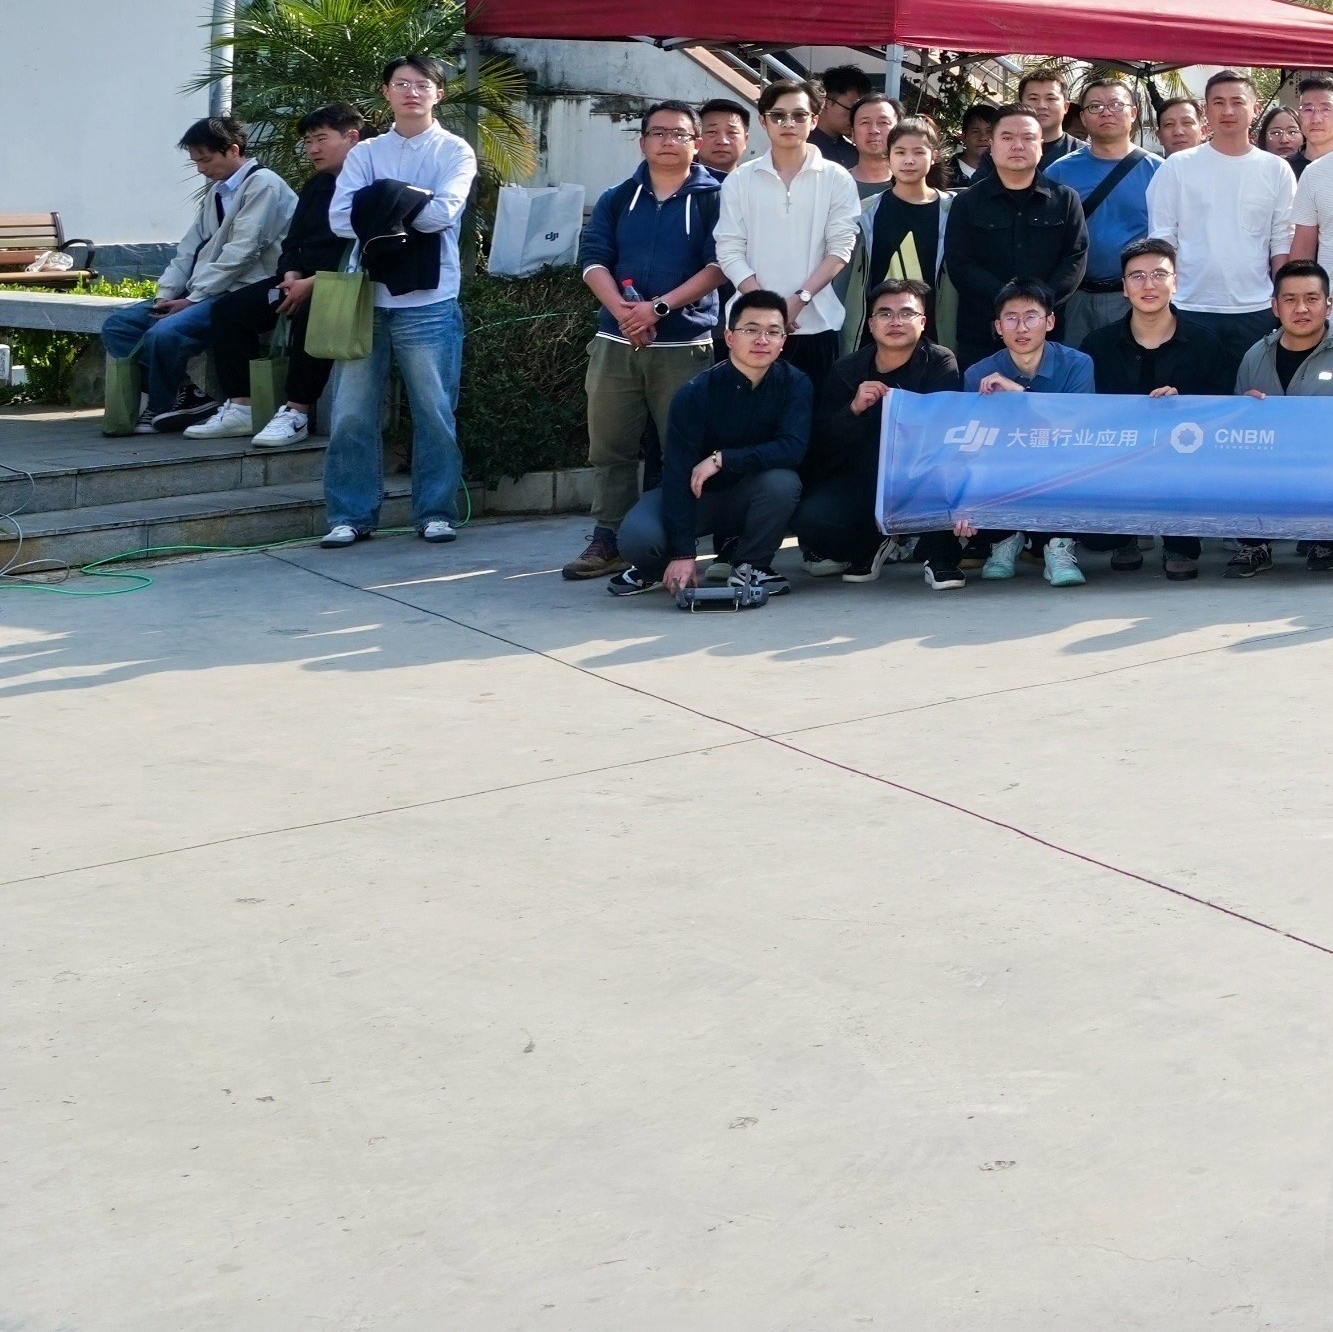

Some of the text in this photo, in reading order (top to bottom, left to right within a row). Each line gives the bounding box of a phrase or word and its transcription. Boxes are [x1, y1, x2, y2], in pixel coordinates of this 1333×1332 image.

[1007, 428, 1139, 448] 大疆行业应用
[1215, 429, 1275, 444] CNBM
